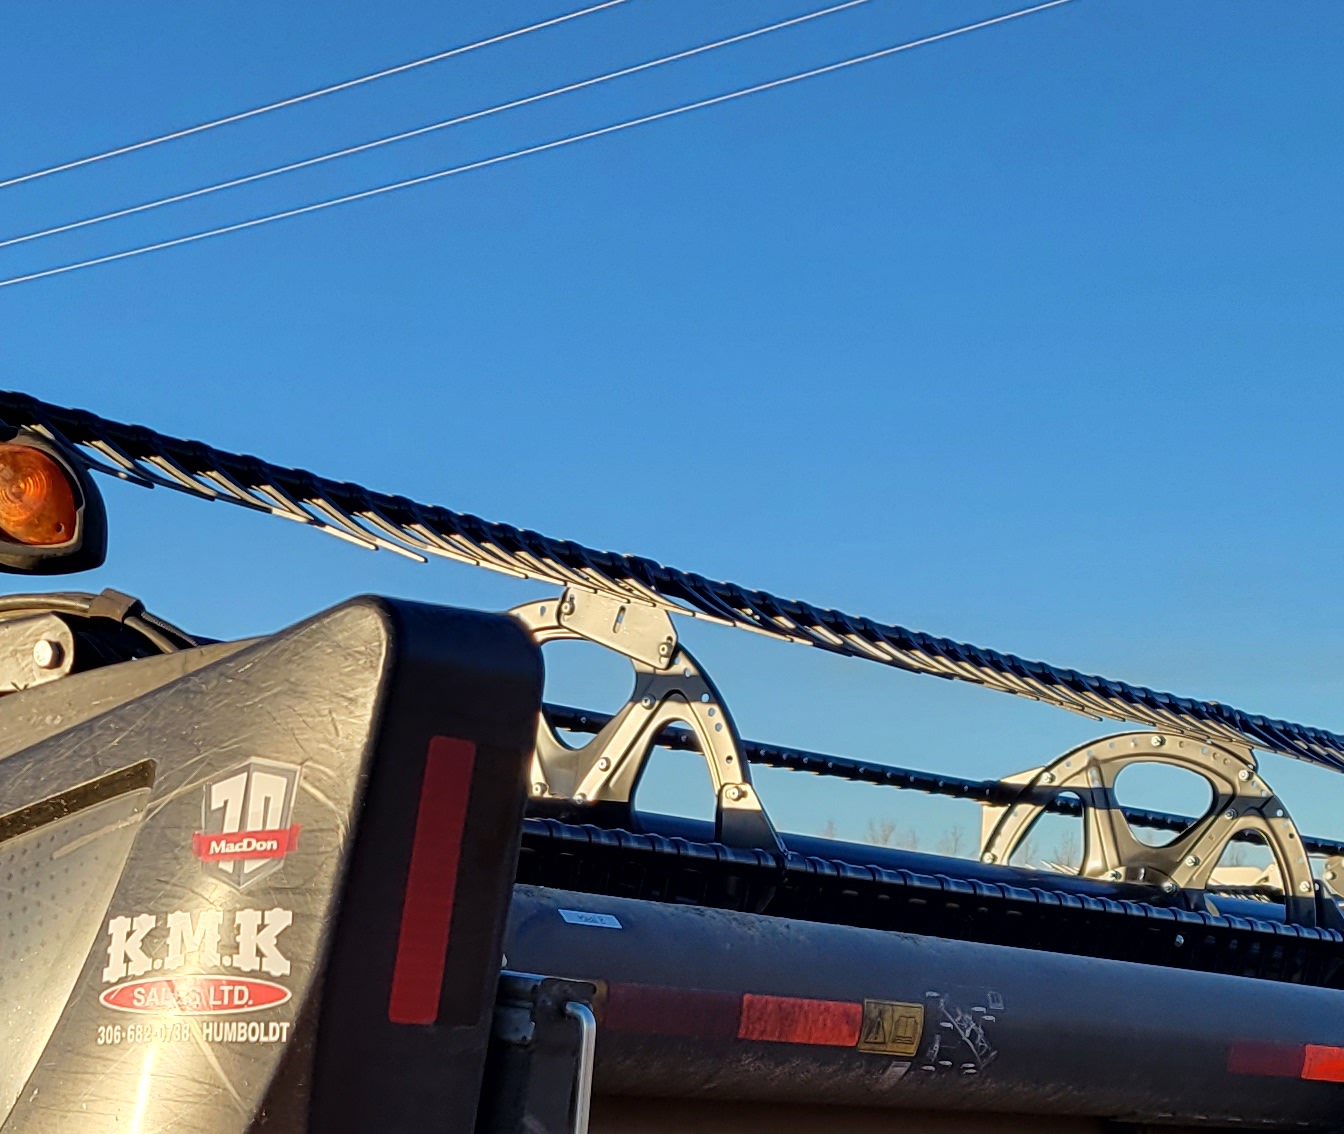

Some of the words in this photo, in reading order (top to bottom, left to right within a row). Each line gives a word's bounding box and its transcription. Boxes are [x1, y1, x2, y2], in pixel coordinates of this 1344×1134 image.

[209, 838, 278, 856] MacDon
[102, 907, 293, 984] K.M.K
[132, 986, 202, 1008] SALS
[209, 985, 254, 1006] LTD.
[203, 1021, 291, 1044] HUMBOLDT
